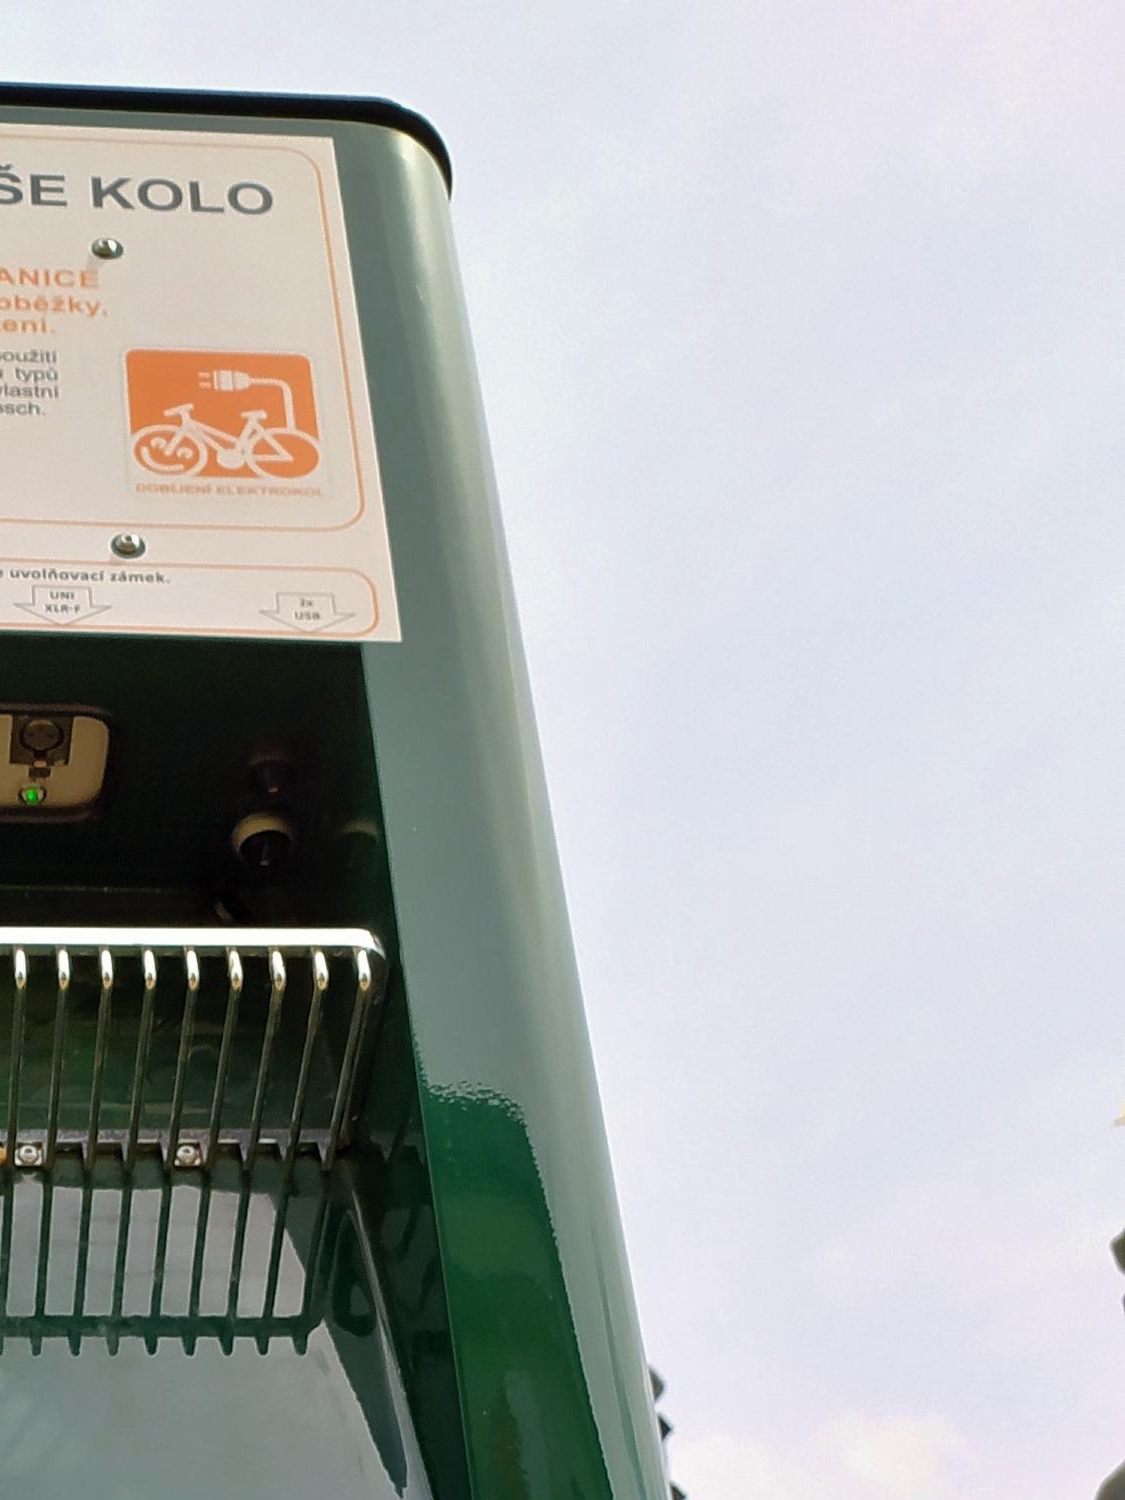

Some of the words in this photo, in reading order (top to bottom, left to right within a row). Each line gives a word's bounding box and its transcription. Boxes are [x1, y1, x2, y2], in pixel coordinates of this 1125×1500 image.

[90, 176, 274, 215] KOLO
[15, 366, 59, 383] typů
[10, 567, 105, 581] uvolňovací
[110, 569, 171, 583] zámek.
[49, 590, 75, 600] UNI
